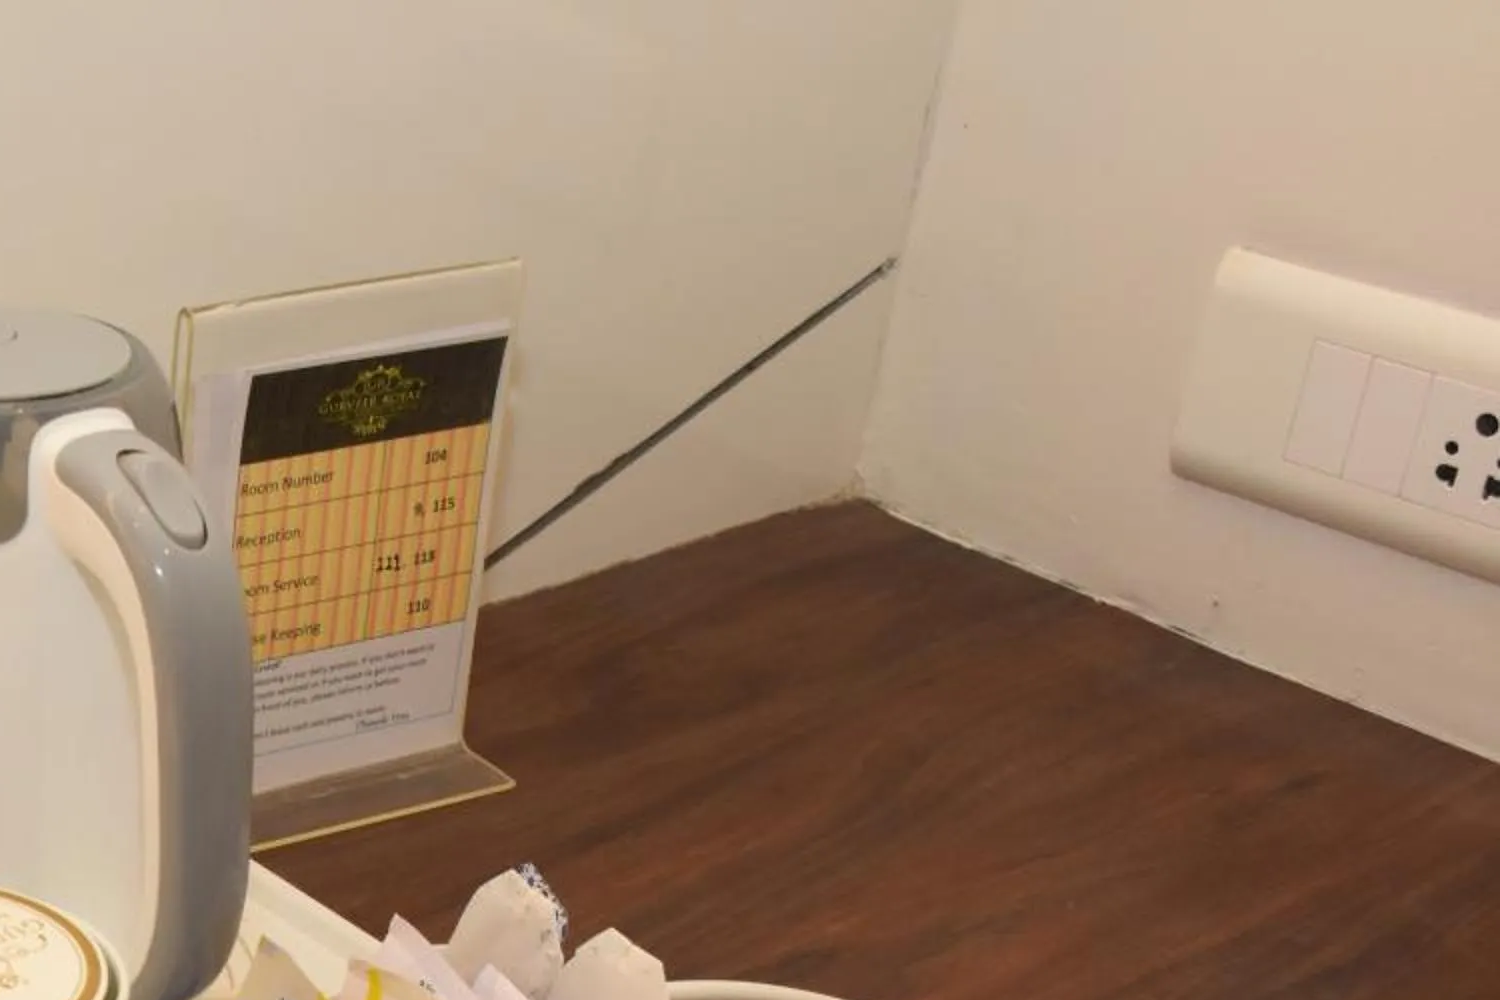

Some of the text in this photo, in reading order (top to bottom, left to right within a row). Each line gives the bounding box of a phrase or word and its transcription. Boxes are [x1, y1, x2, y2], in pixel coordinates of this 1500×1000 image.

[241, 470, 335, 497] Room Number
[236, 526, 303, 549] Reception
[272, 574, 319, 593] Service
[269, 622, 321, 642] Keeping
